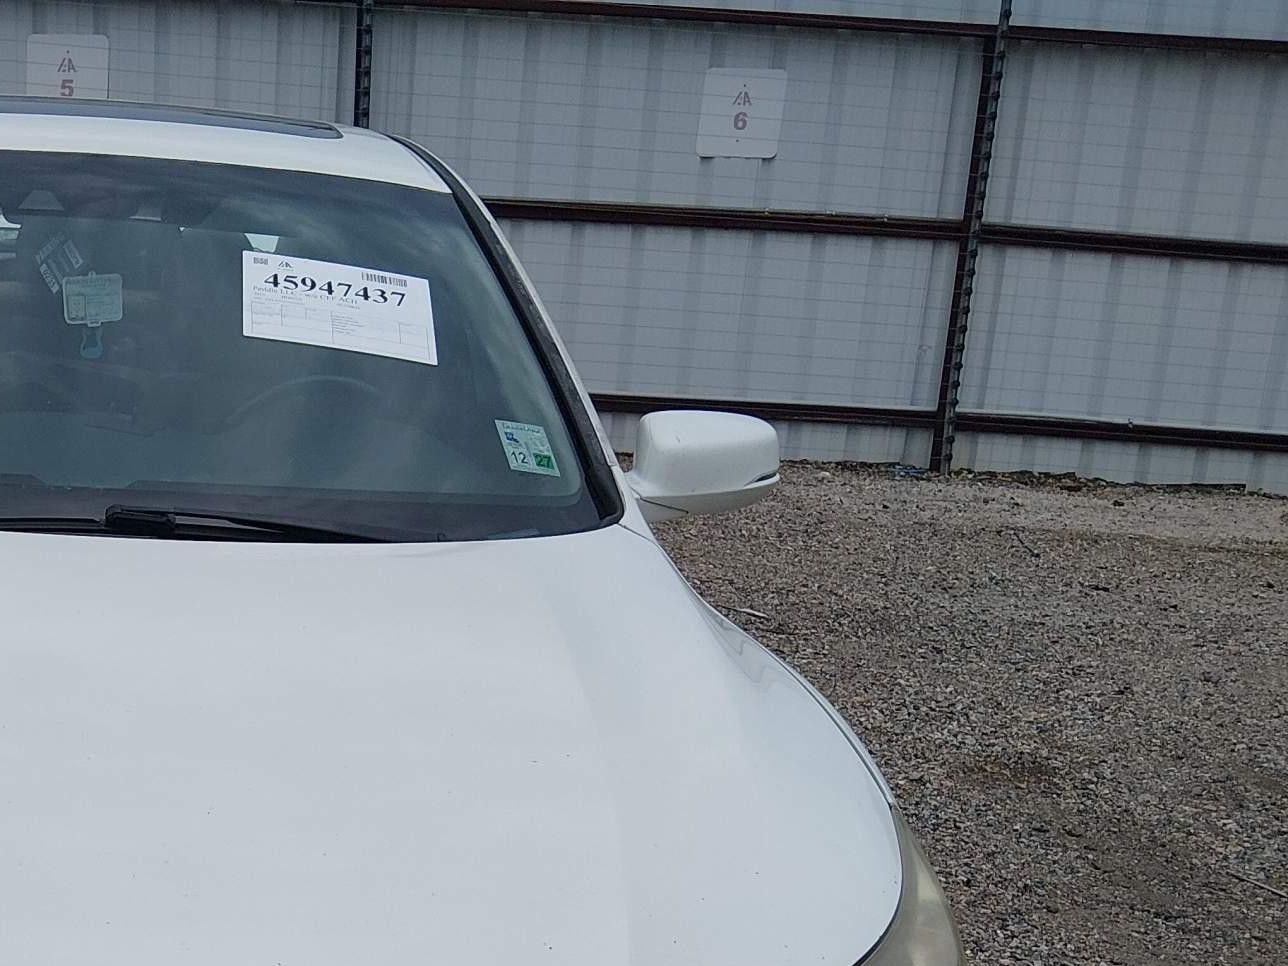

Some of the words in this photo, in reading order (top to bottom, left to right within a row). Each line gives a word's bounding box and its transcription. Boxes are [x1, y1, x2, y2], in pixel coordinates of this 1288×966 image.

[60, 79, 74, 97] 5
[733, 111, 748, 130] 6
[263, 272, 406, 307] 45947437
[510, 451, 529, 465] 12
[534, 454, 553, 468] 27
